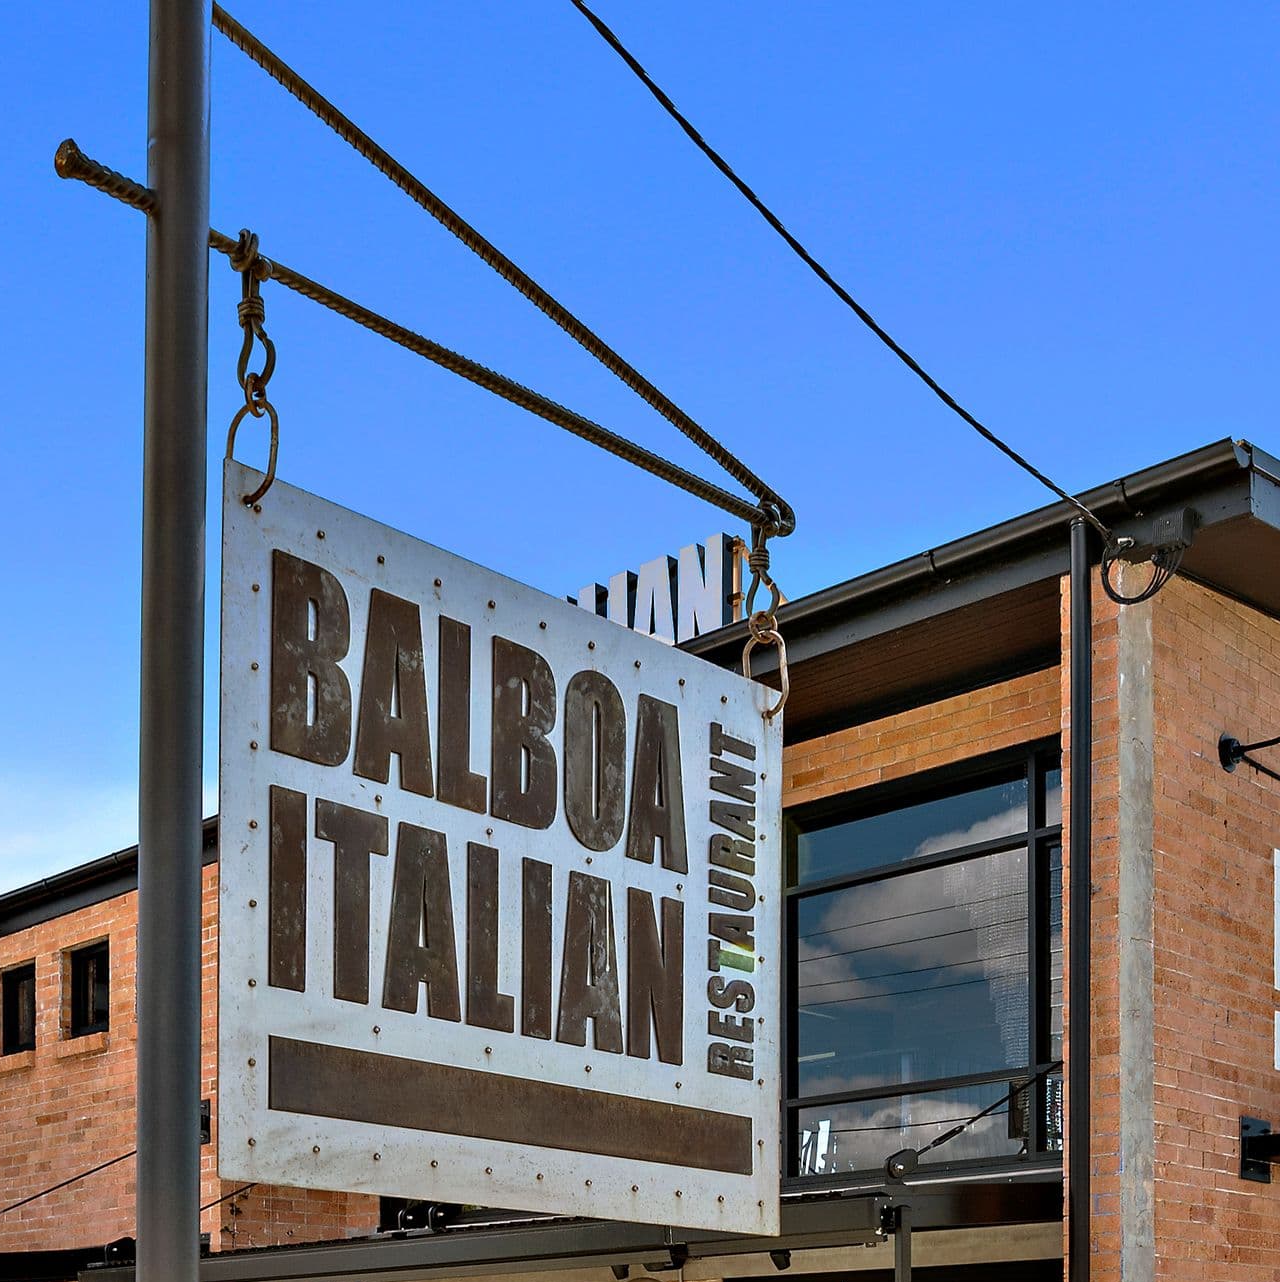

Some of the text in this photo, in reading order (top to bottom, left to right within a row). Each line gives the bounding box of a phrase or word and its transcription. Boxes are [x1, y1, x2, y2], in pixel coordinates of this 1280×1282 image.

[270, 548, 688, 874] BALBOA
[268, 784, 684, 1066] ITALIAN
[707, 723, 757, 1081] RESTAURANT
